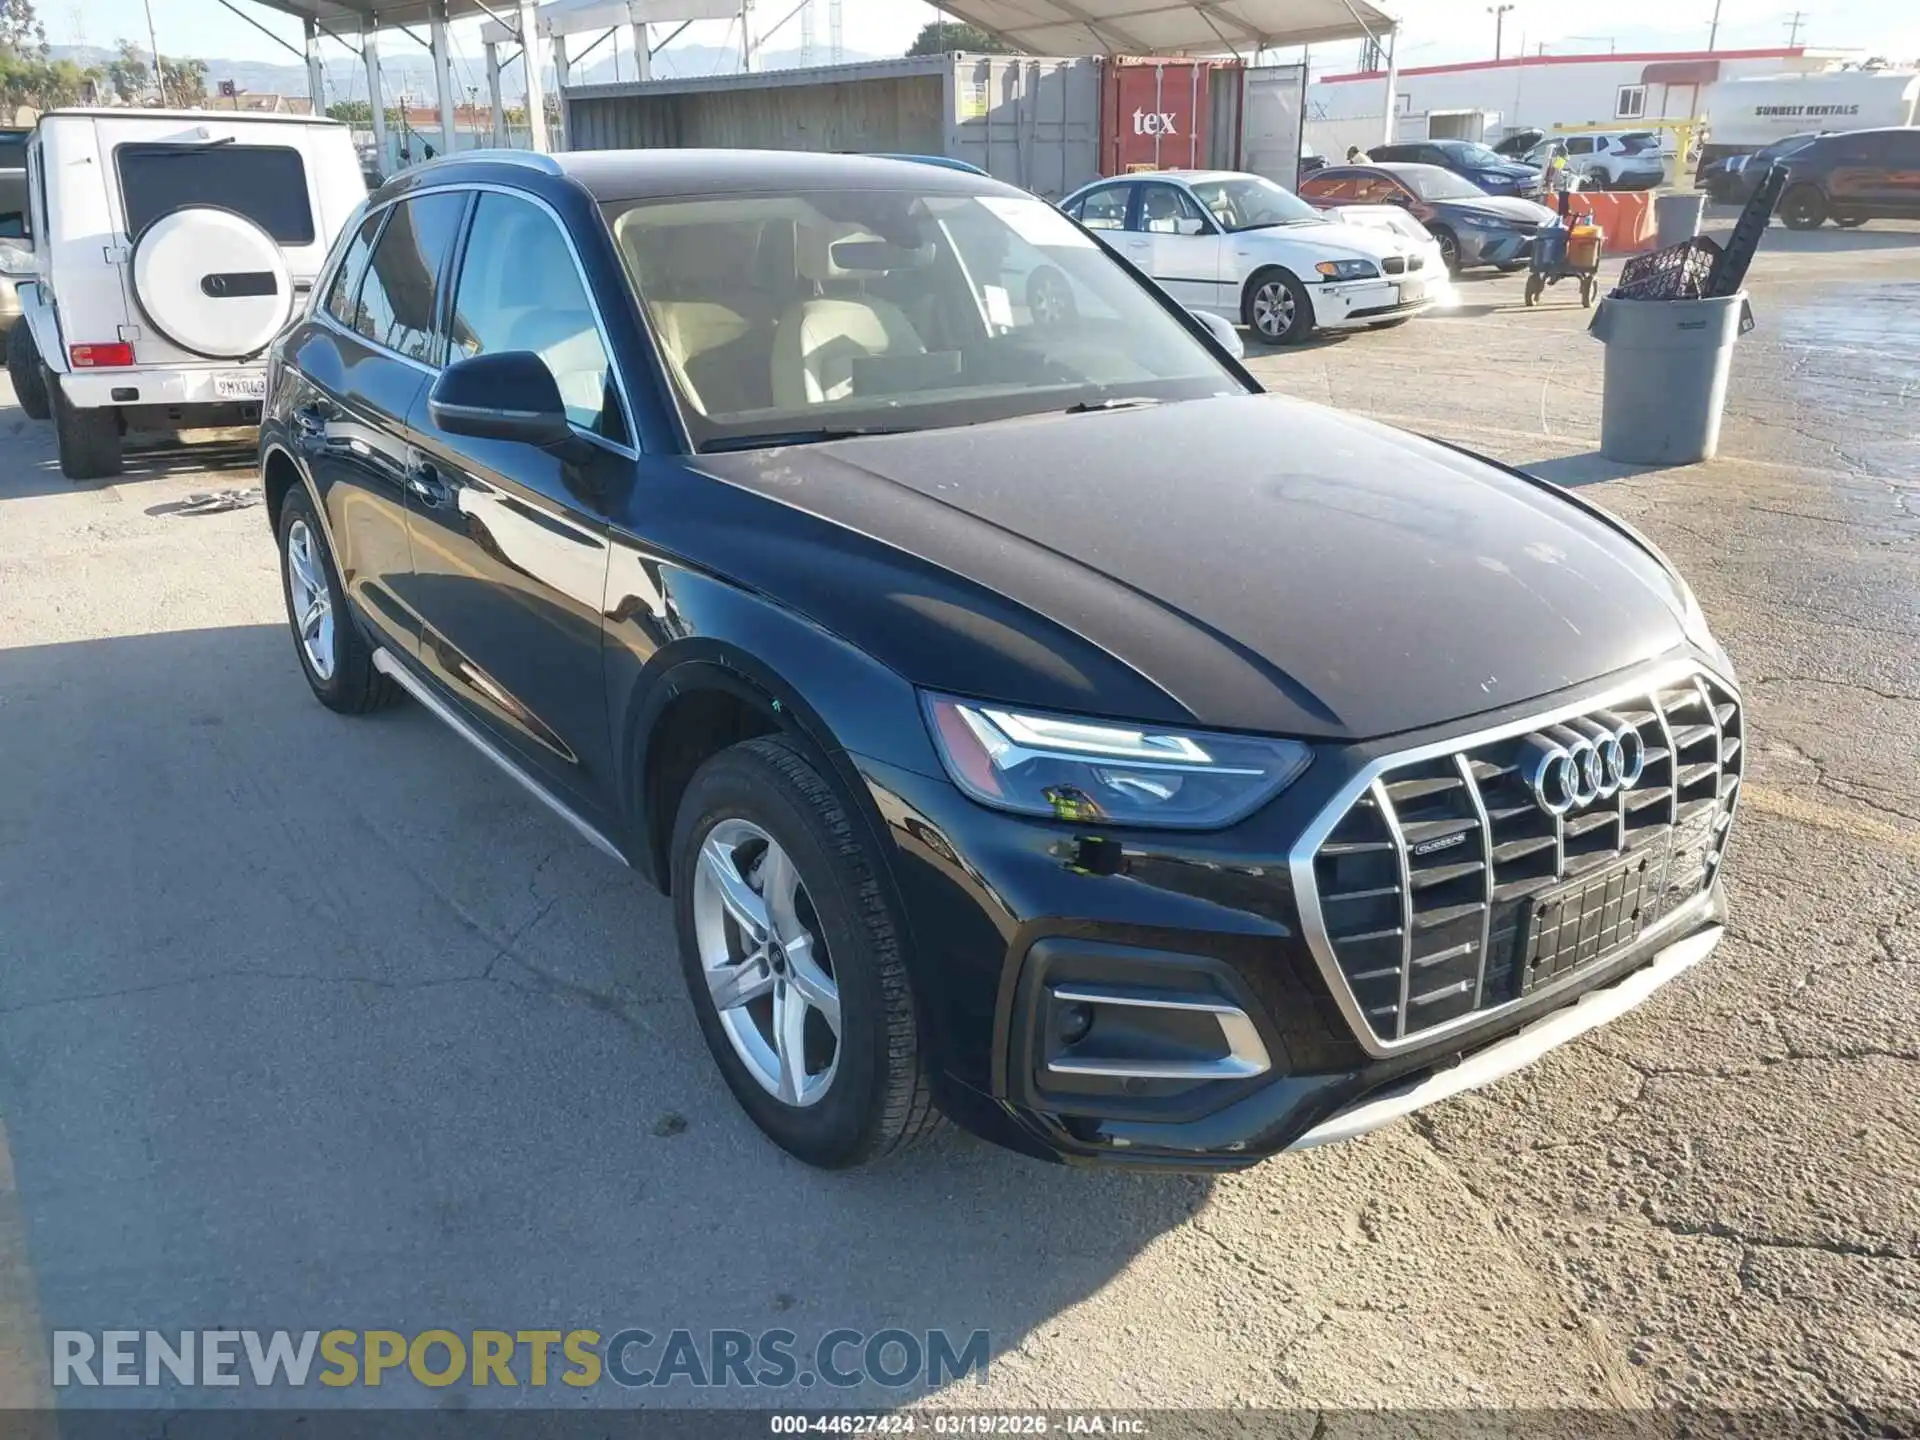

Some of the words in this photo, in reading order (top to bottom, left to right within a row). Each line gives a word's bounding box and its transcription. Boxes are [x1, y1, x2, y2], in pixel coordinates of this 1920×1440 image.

[1132, 105, 1177, 135] tex
[1755, 105, 1804, 116] SUNBELT
[1805, 104, 1859, 115] RENTALS
